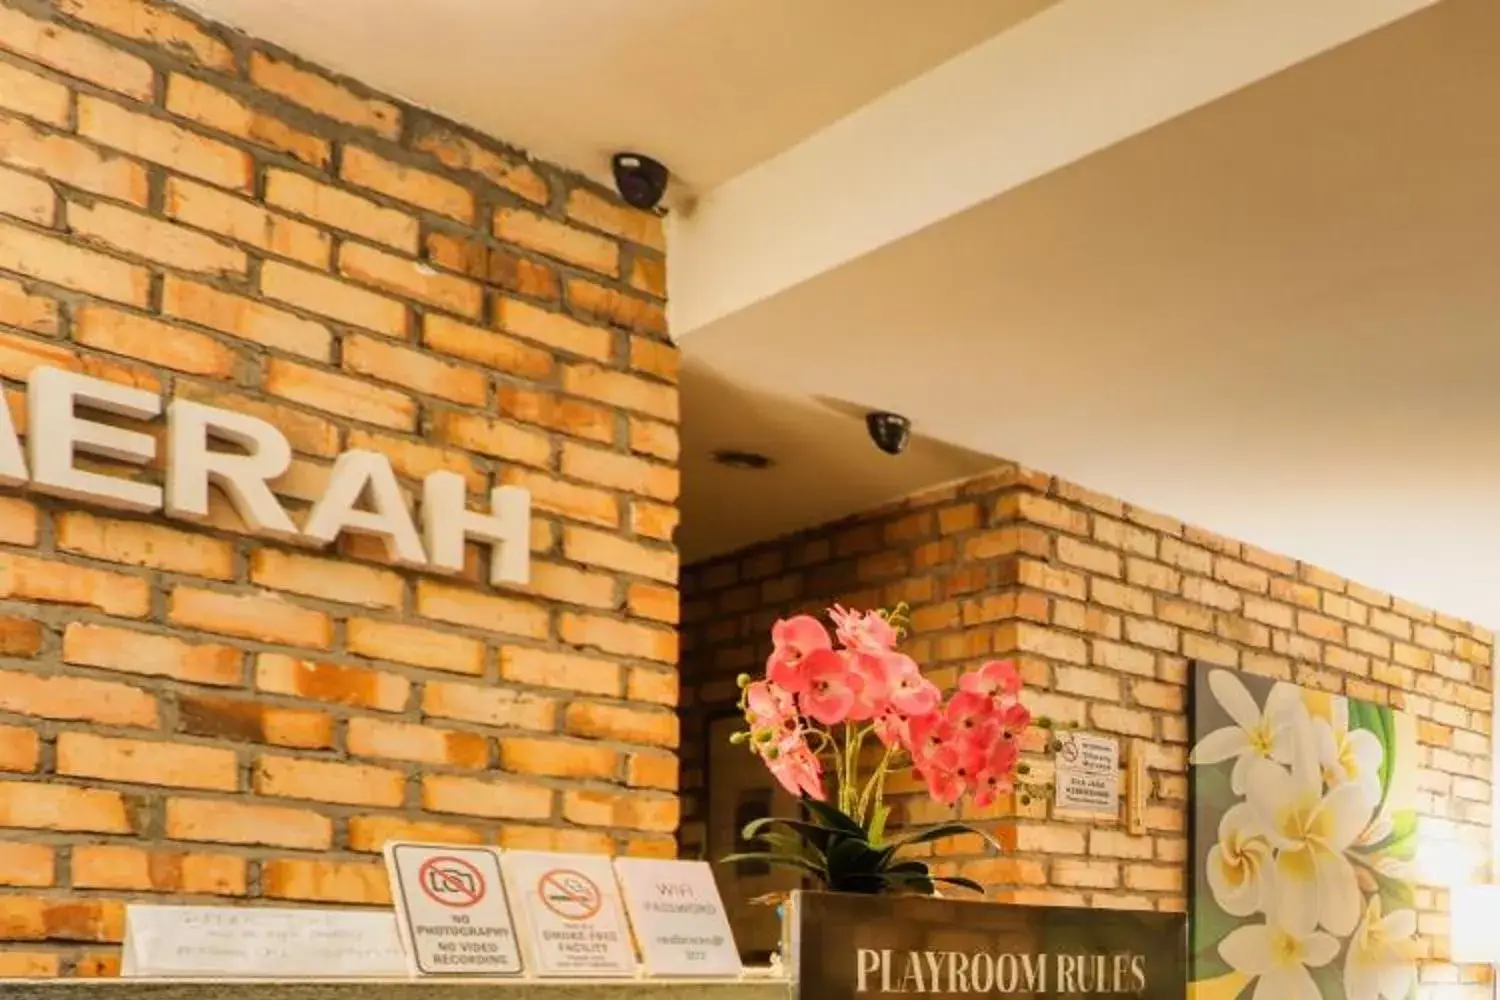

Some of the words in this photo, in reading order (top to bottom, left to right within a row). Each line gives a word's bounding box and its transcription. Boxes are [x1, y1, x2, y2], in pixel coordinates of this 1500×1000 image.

[451, 914, 471, 925] NO
[415, 925, 509, 938] PHOTOGRAPHY
[438, 941, 457, 953] NO
[460, 941, 498, 954] VIDEO
[432, 954, 509, 966] RECORDING
[855, 947, 1048, 995] PLAYROOM
[1056, 953, 1146, 994] RULES
